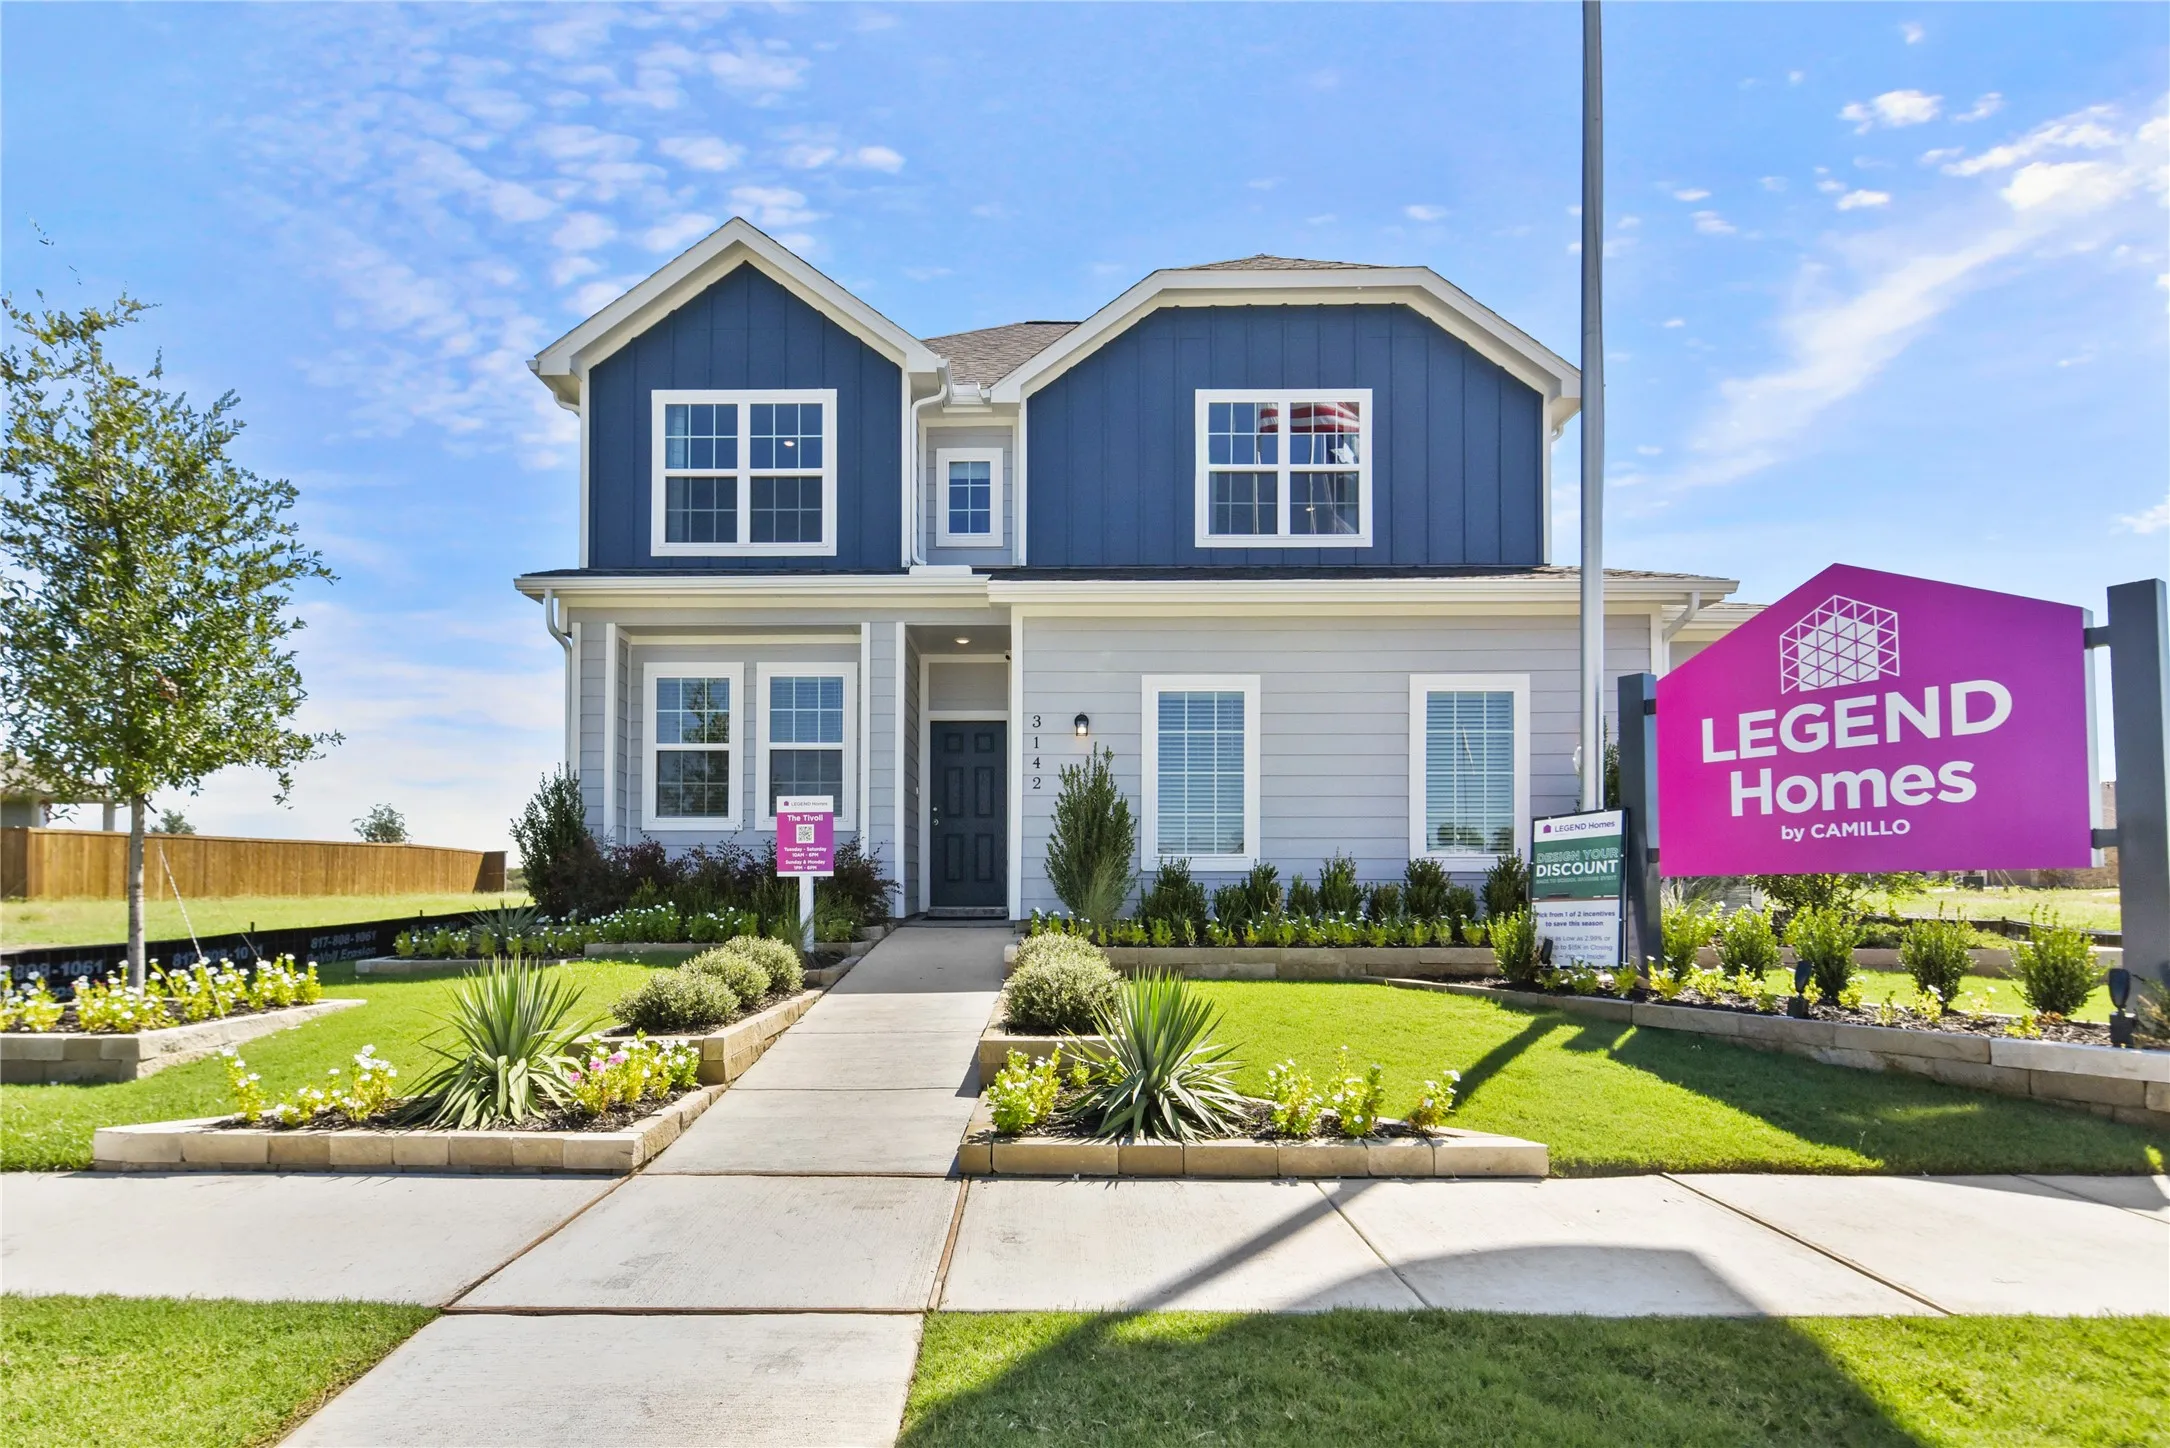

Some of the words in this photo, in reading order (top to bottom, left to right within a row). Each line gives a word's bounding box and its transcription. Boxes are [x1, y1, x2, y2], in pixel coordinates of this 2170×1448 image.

[1701, 679, 2013, 764] LEGEND
[1730, 761, 1977, 817] Homes
[803, 814, 824, 822] Tivoli
[1554, 823, 1587, 833] LEGEND
[1588, 821, 1615, 830] Homes
[1781, 825, 1806, 843] by
[1811, 819, 1911, 840] CAMILLO
[1536, 850, 1581, 864] DESIGN
[1583, 847, 1619, 860] YOUR
[1536, 859, 1619, 878] DISCOUNT
